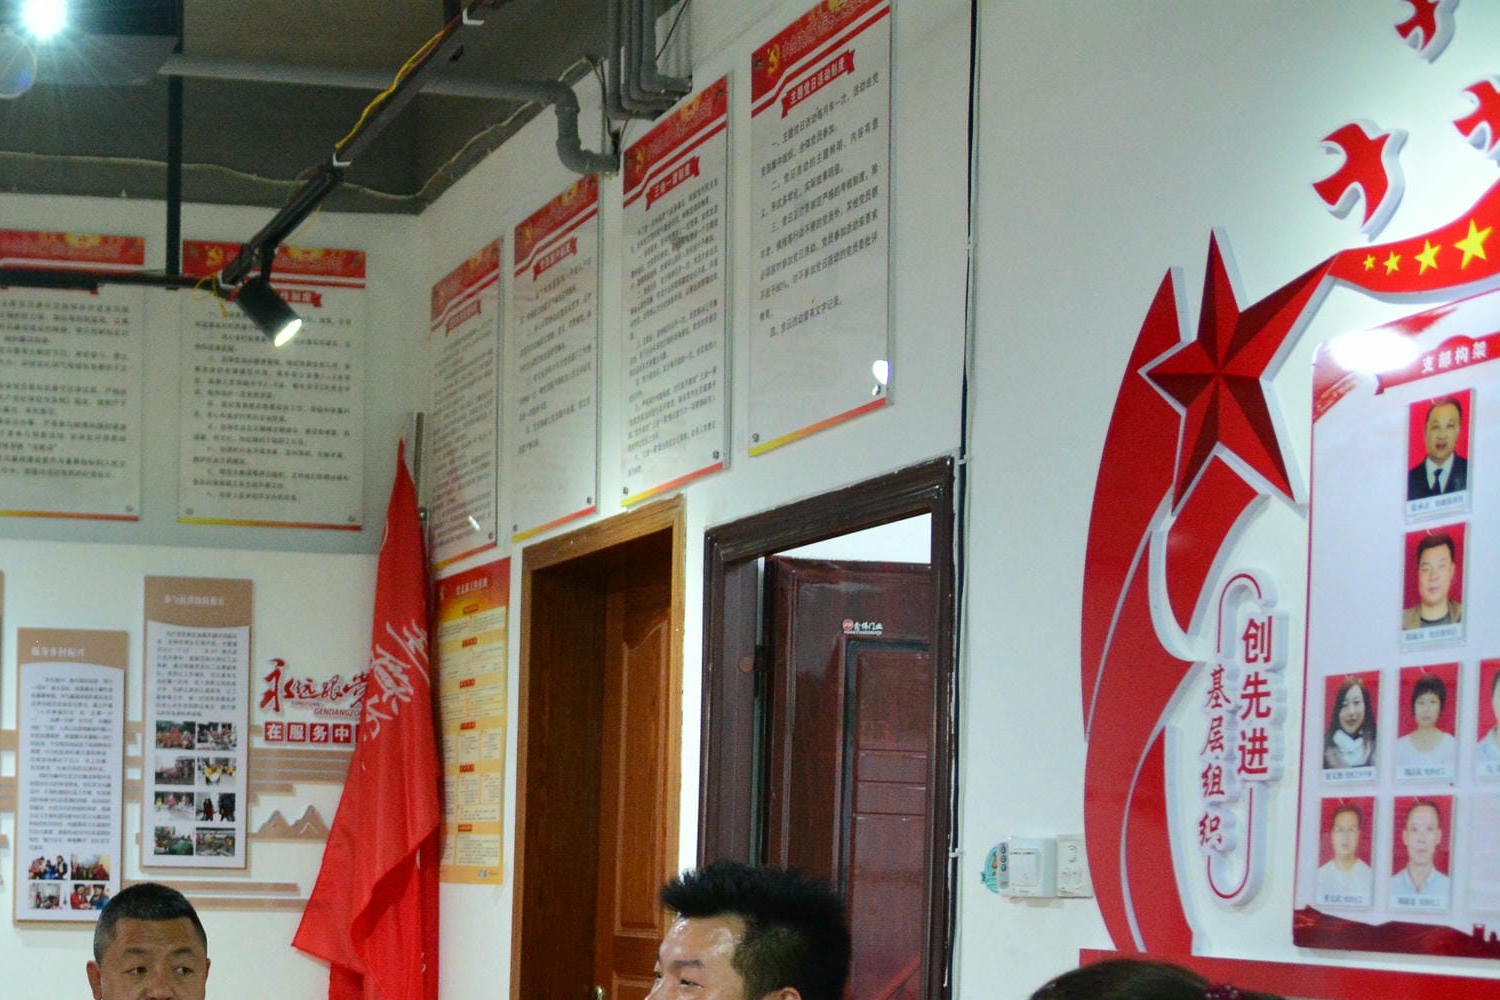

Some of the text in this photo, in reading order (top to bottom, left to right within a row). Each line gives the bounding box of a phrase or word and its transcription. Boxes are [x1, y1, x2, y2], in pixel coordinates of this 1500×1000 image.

[1420, 340, 1488, 374] 支部构架
[266, 723, 351, 743] 在服务中
[1237, 615, 1273, 775] 创先进
[1199, 664, 1232, 846] 基层组织
